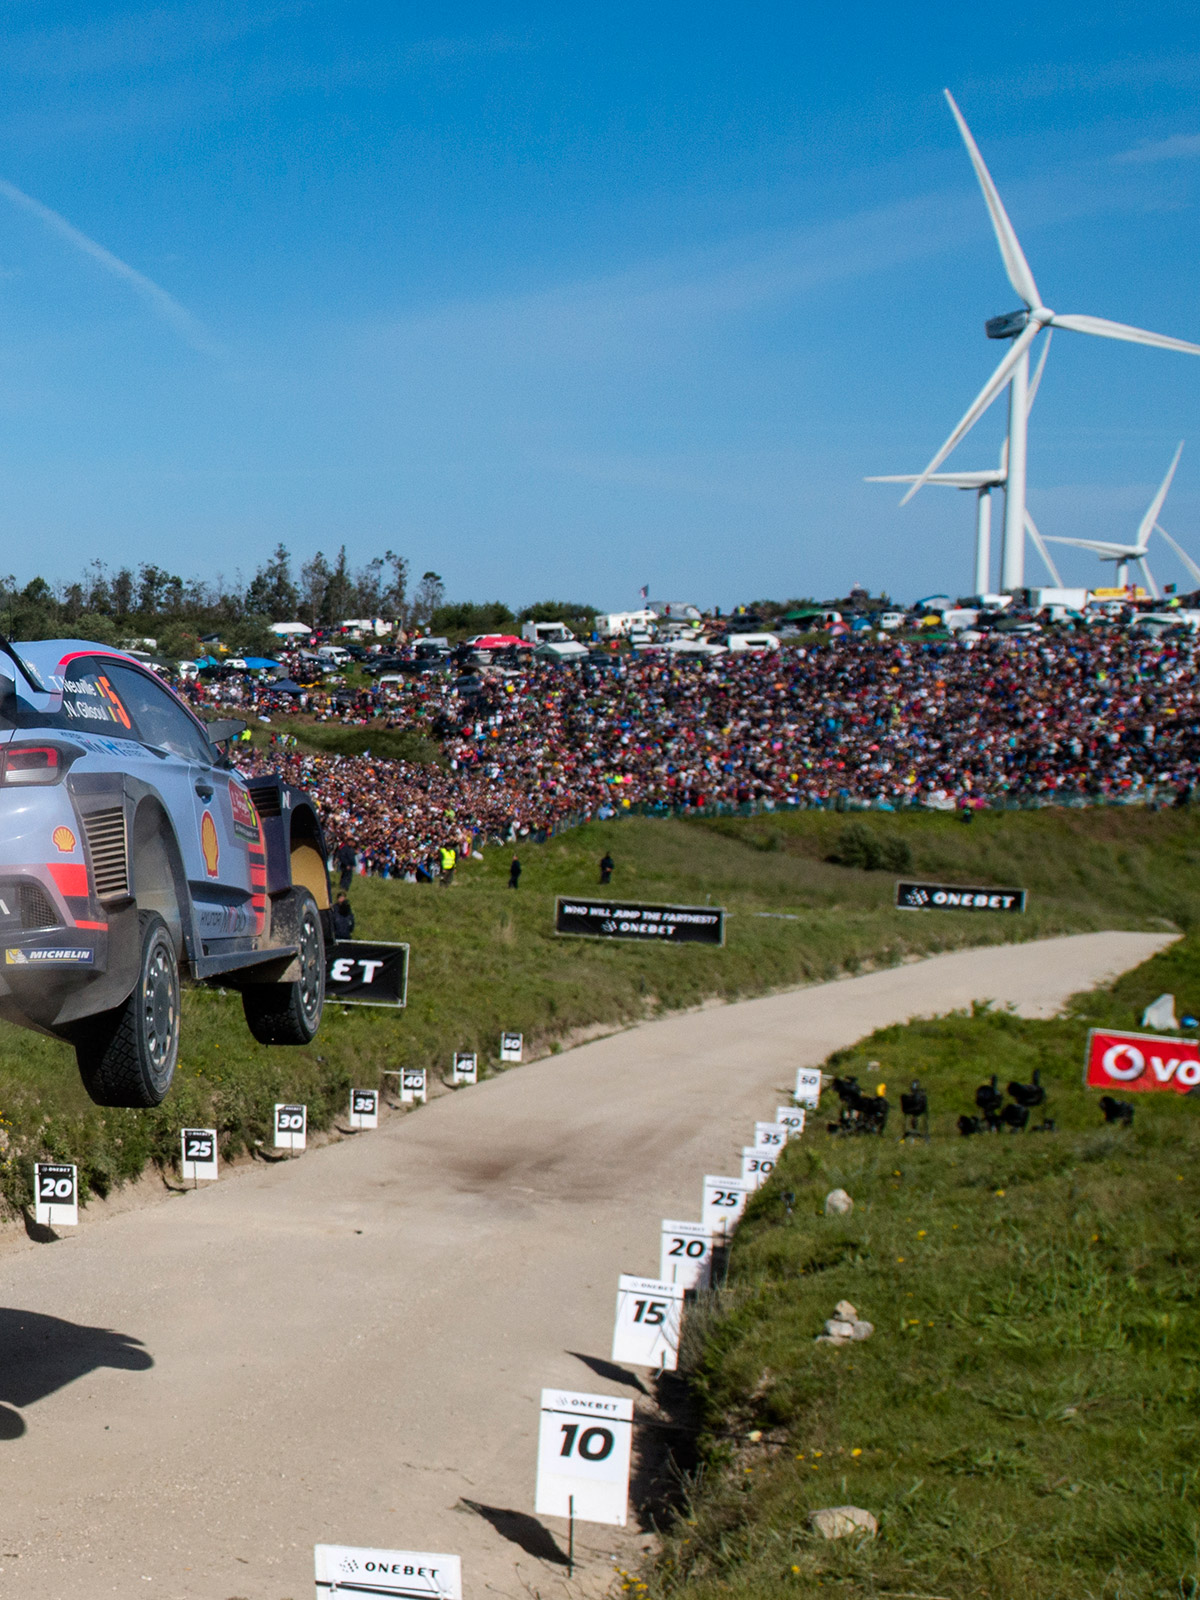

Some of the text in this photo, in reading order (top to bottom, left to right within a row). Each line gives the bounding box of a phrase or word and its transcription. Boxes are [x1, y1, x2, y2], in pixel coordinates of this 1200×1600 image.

[63, 700, 80, 718] N.
[98, 676, 132, 730] 5
[932, 891, 1015, 909] ONEBET
[564, 904, 588, 915] WHO
[589, 906, 612, 918] WILL
[612, 908, 641, 920] JUMP
[642, 910, 662, 922] THE
[619, 921, 677, 935] ONEBET
[29, 949, 90, 960] MICHELIN
[504, 1038, 521, 1049] 50
[457, 1059, 474, 1071] 45
[404, 1075, 424, 1088] 40
[801, 1075, 818, 1085] 50
[354, 1097, 374, 1111] 35
[278, 1114, 303, 1129] 30
[781, 1117, 801, 1128] 40
[761, 1133, 781, 1145] 35
[187, 1140, 212, 1158] 25
[748, 1160, 774, 1174] 30
[40, 1178, 73, 1198] 20
[711, 1190, 739, 1207] 25
[668, 1238, 707, 1259] 20
[641, 1282, 675, 1292] ONEBET
[633, 1300, 668, 1326] 15
[571, 1398, 619, 1412] ONEBET
[560, 1424, 615, 1462] 10
[365, 1561, 440, 1578] ONEBET
